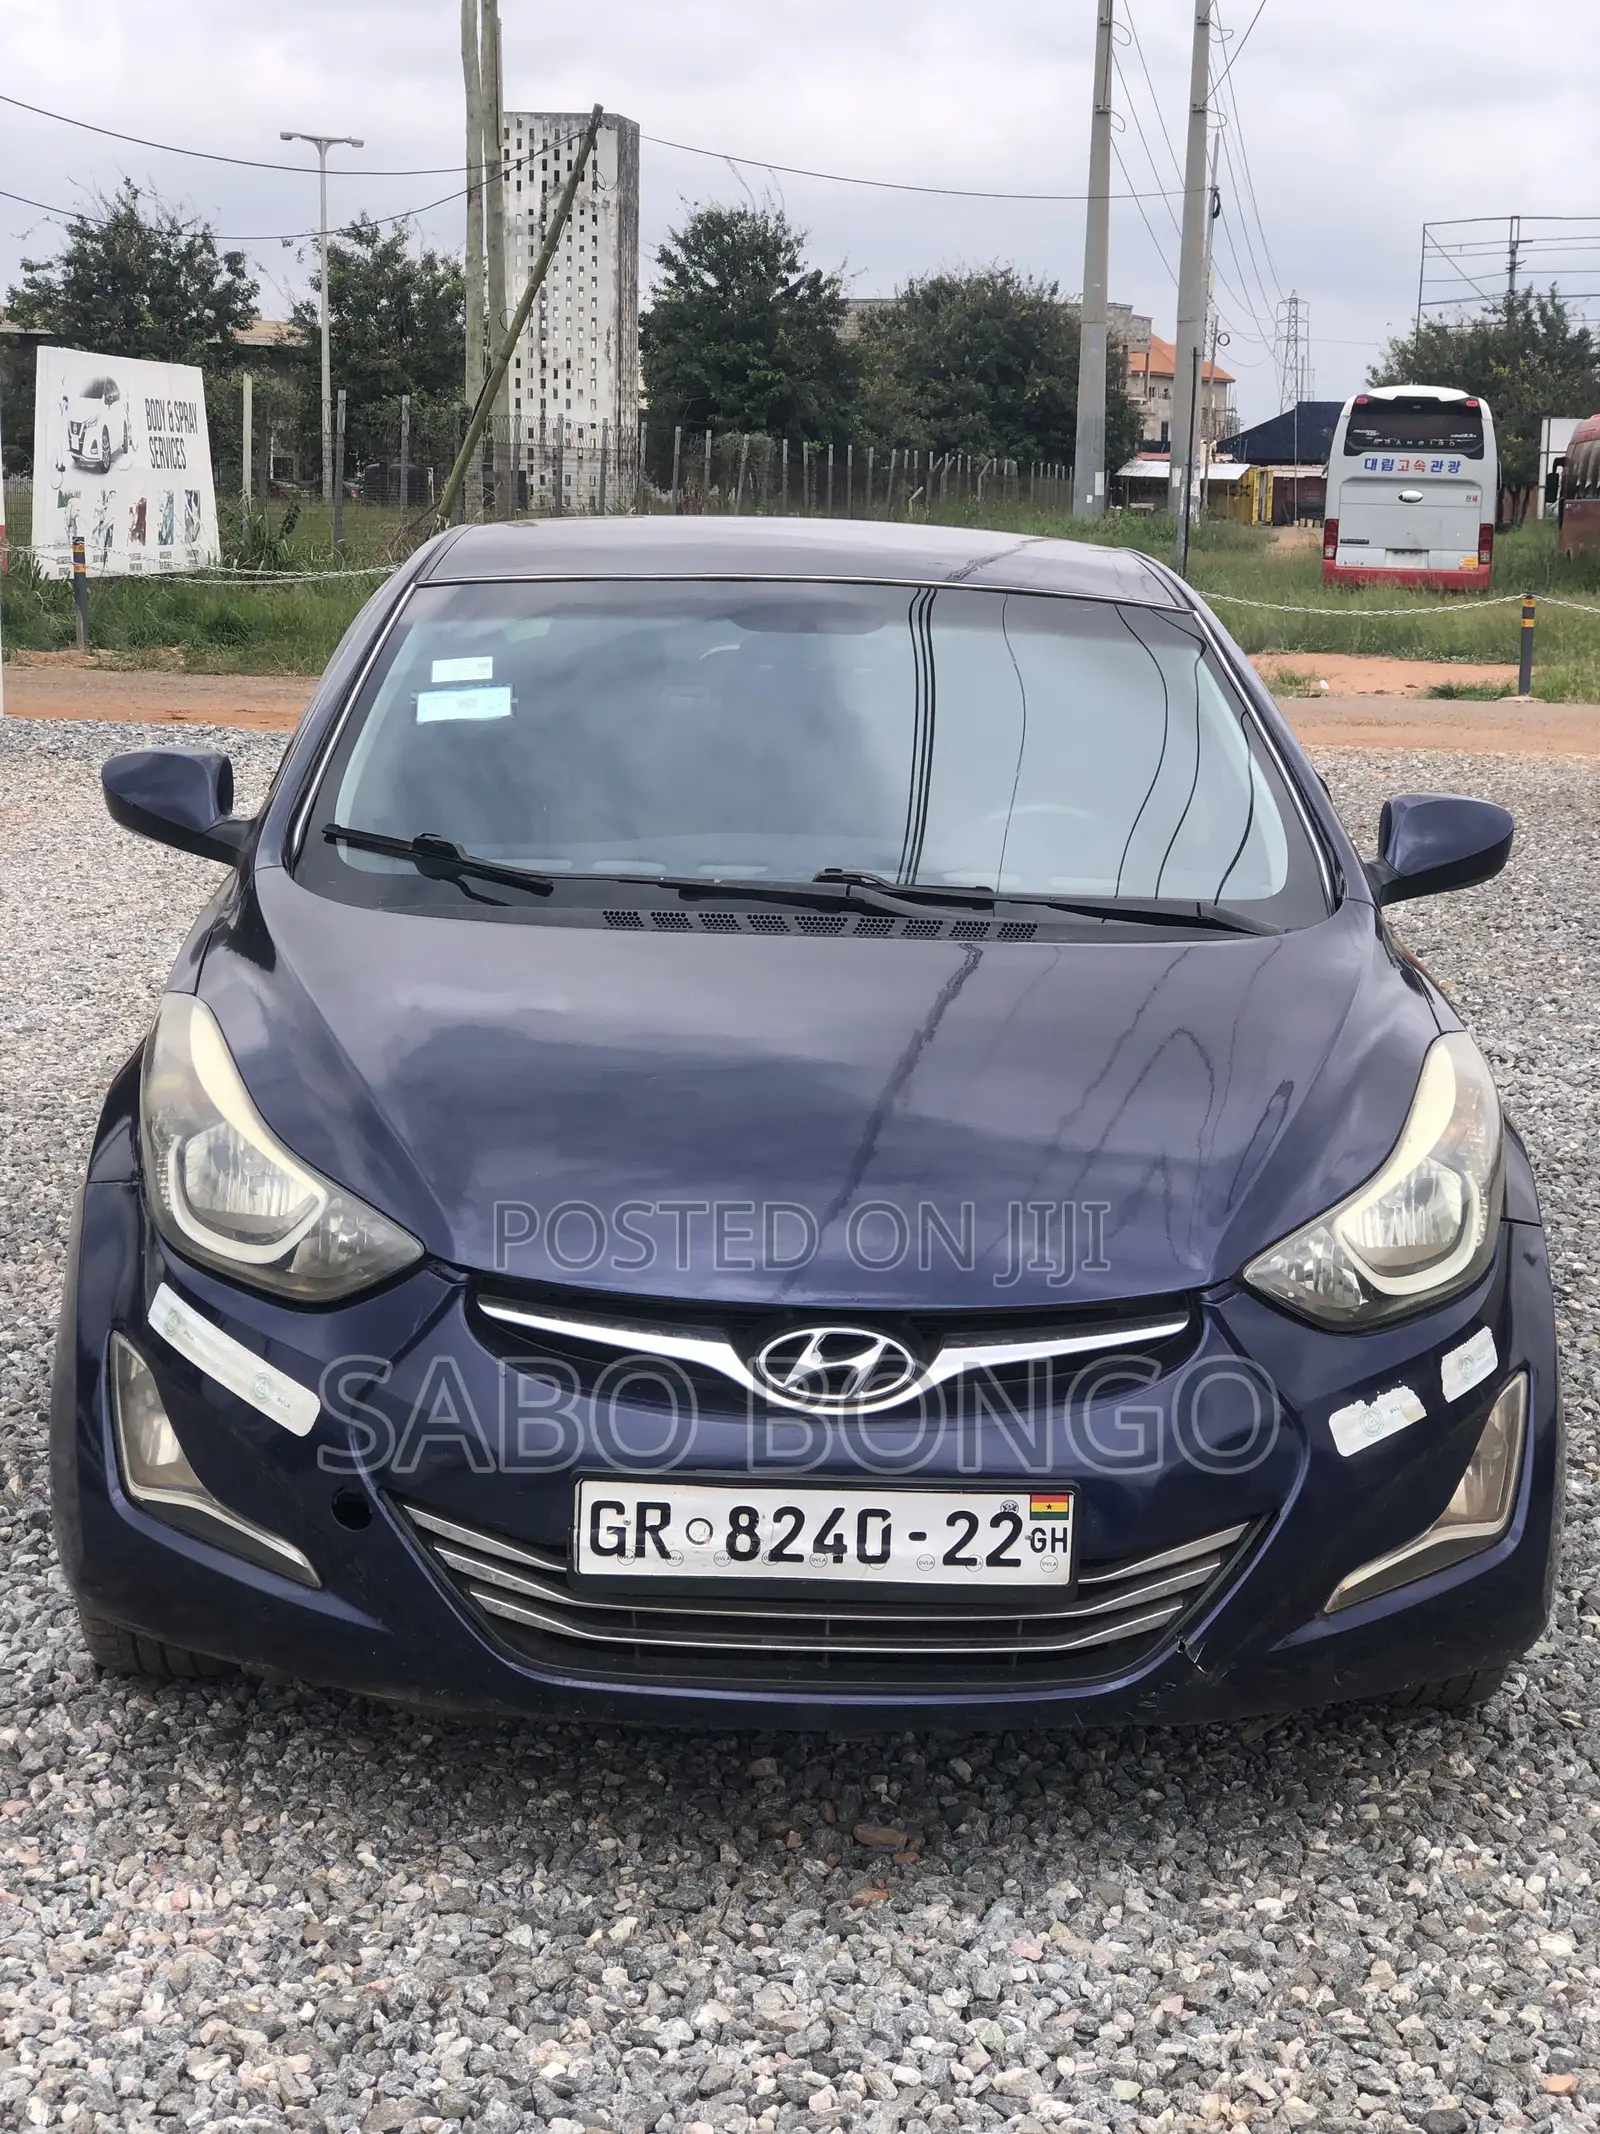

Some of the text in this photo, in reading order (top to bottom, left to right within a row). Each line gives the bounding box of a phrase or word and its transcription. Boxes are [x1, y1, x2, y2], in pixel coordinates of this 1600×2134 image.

[144, 397, 198, 434] BODY & SPRAY
[148, 435, 187, 470] SERVICES
[1364, 457, 1461, 474] 대림고속관광
[590, 1500, 672, 1559] GR
[1029, 1527, 1068, 1554] GH
